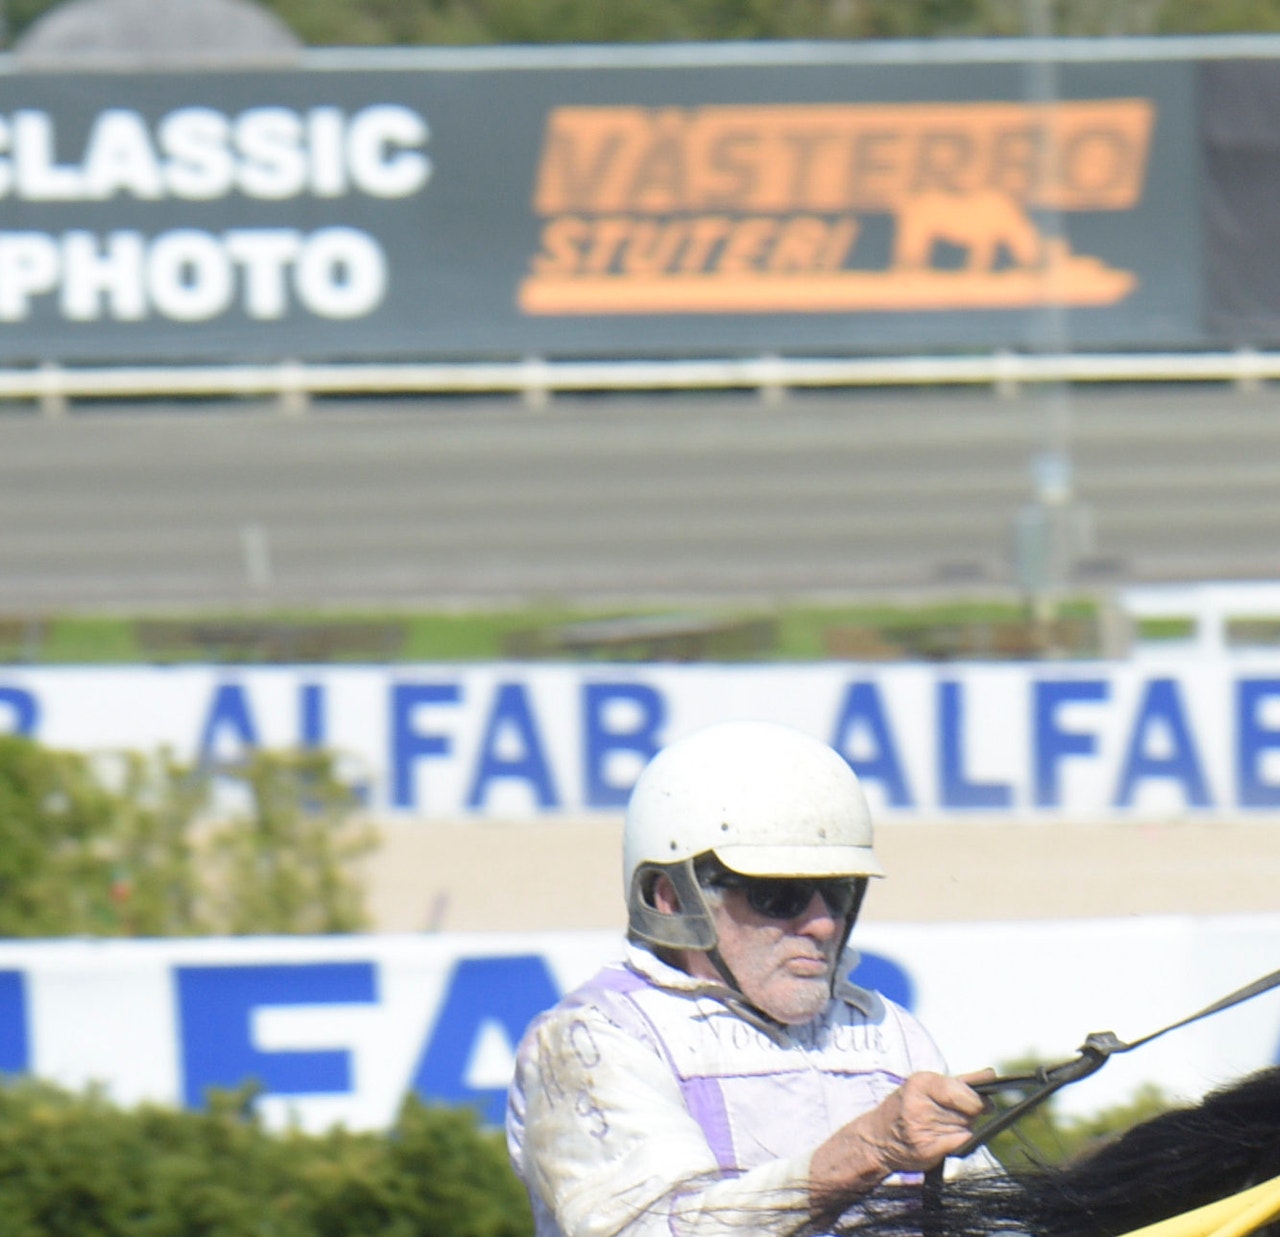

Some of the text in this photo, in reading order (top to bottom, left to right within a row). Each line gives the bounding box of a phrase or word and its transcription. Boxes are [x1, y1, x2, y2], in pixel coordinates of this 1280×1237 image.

[0, 104, 432, 201] LASSIC
[0, 226, 389, 322] PHOTO
[535, 214, 860, 275] STUTERI
